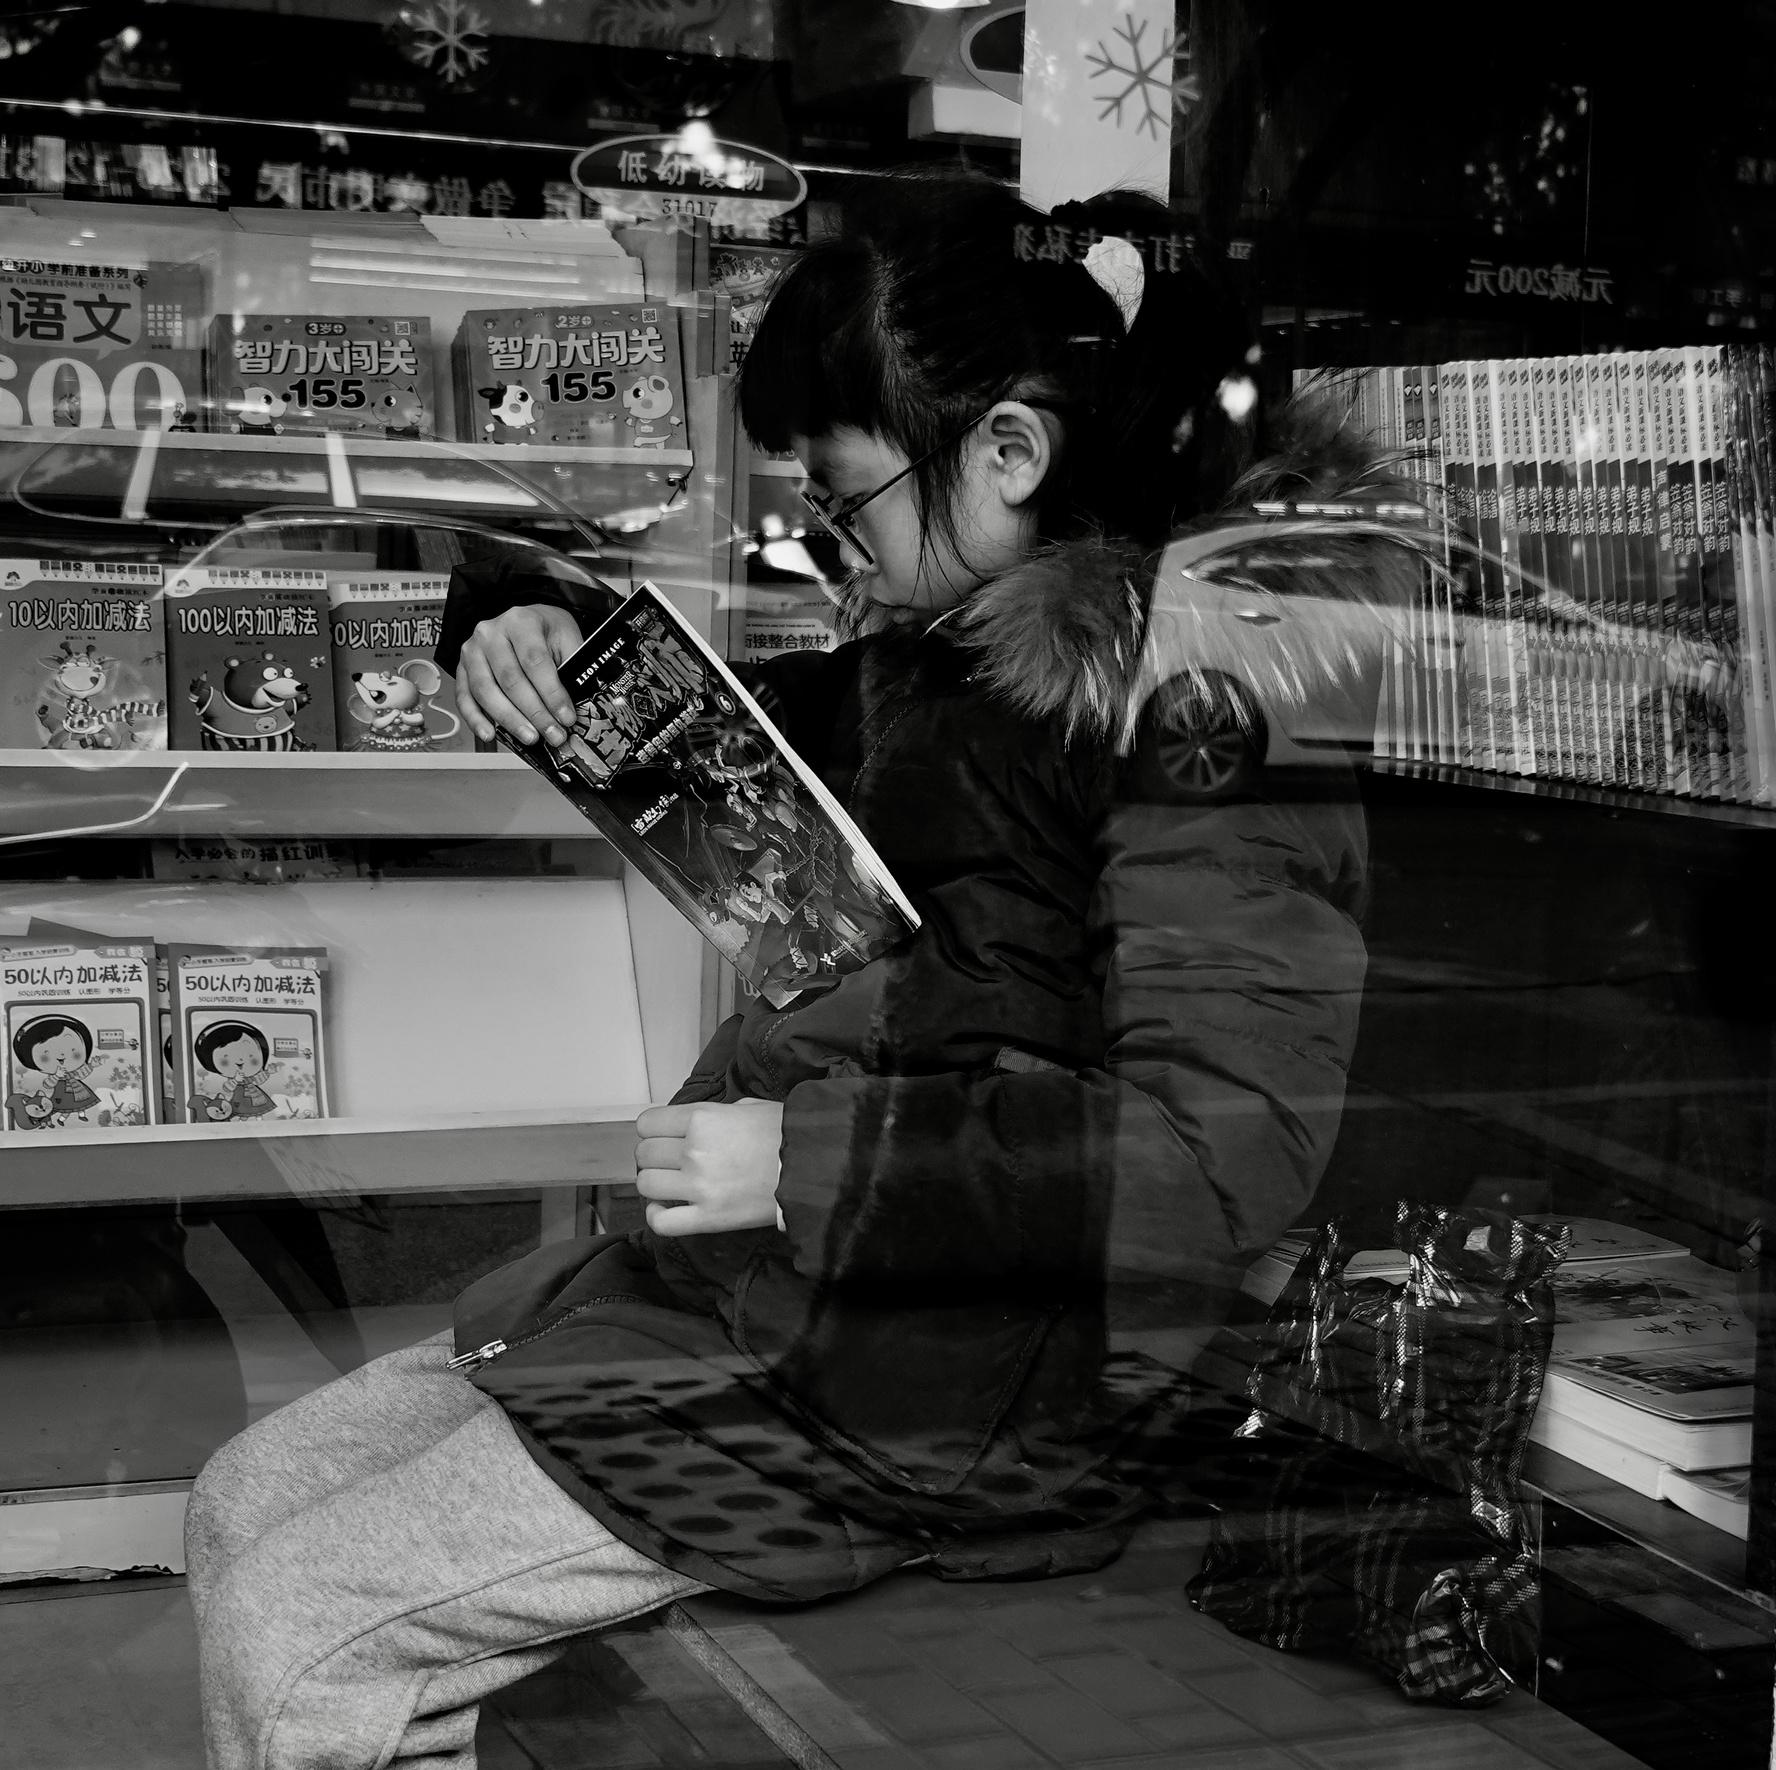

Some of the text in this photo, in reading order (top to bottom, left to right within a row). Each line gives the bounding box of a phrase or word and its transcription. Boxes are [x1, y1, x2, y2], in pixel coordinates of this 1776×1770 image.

[7, 288, 131, 345] 语文
[235, 339, 418, 375] 智力大闯关
[488, 327, 665, 370] 智力大闯关
[0, 354, 187, 431] 00
[289, 378, 367, 410] 155
[541, 371, 616, 404] 155
[1528, 486, 1540, 536] 弟子规
[1542, 485, 1556, 535] 弟子规
[1554, 485, 1569, 536] 弟子规
[1567, 486, 1580, 537] 弟子规
[1582, 485, 1596, 536] 弟子规
[1597, 485, 1610, 536] 弟子规
[1610, 485, 1624, 536] 弟子规
[1626, 484, 1640, 536] 弟子规
[1641, 486, 1654, 538] 弟子规
[1655, 470, 1671, 552] 声律启蒙
[1670, 483, 1684, 555] 笠翁对韵
[1681, 483, 1697, 556] 笠翁对韵
[1700, 481, 1716, 553] 笠翁对韵
[1714, 481, 1731, 553] 笠翁对韵
[8, 598, 152, 632] 10以内加减法
[178, 604, 319, 636] 100以内加减法
[576, 637, 626, 686] LEON IMAGE
[5, 964, 142, 985] 50以内加减法
[185, 974, 316, 995] 50以内加减法
